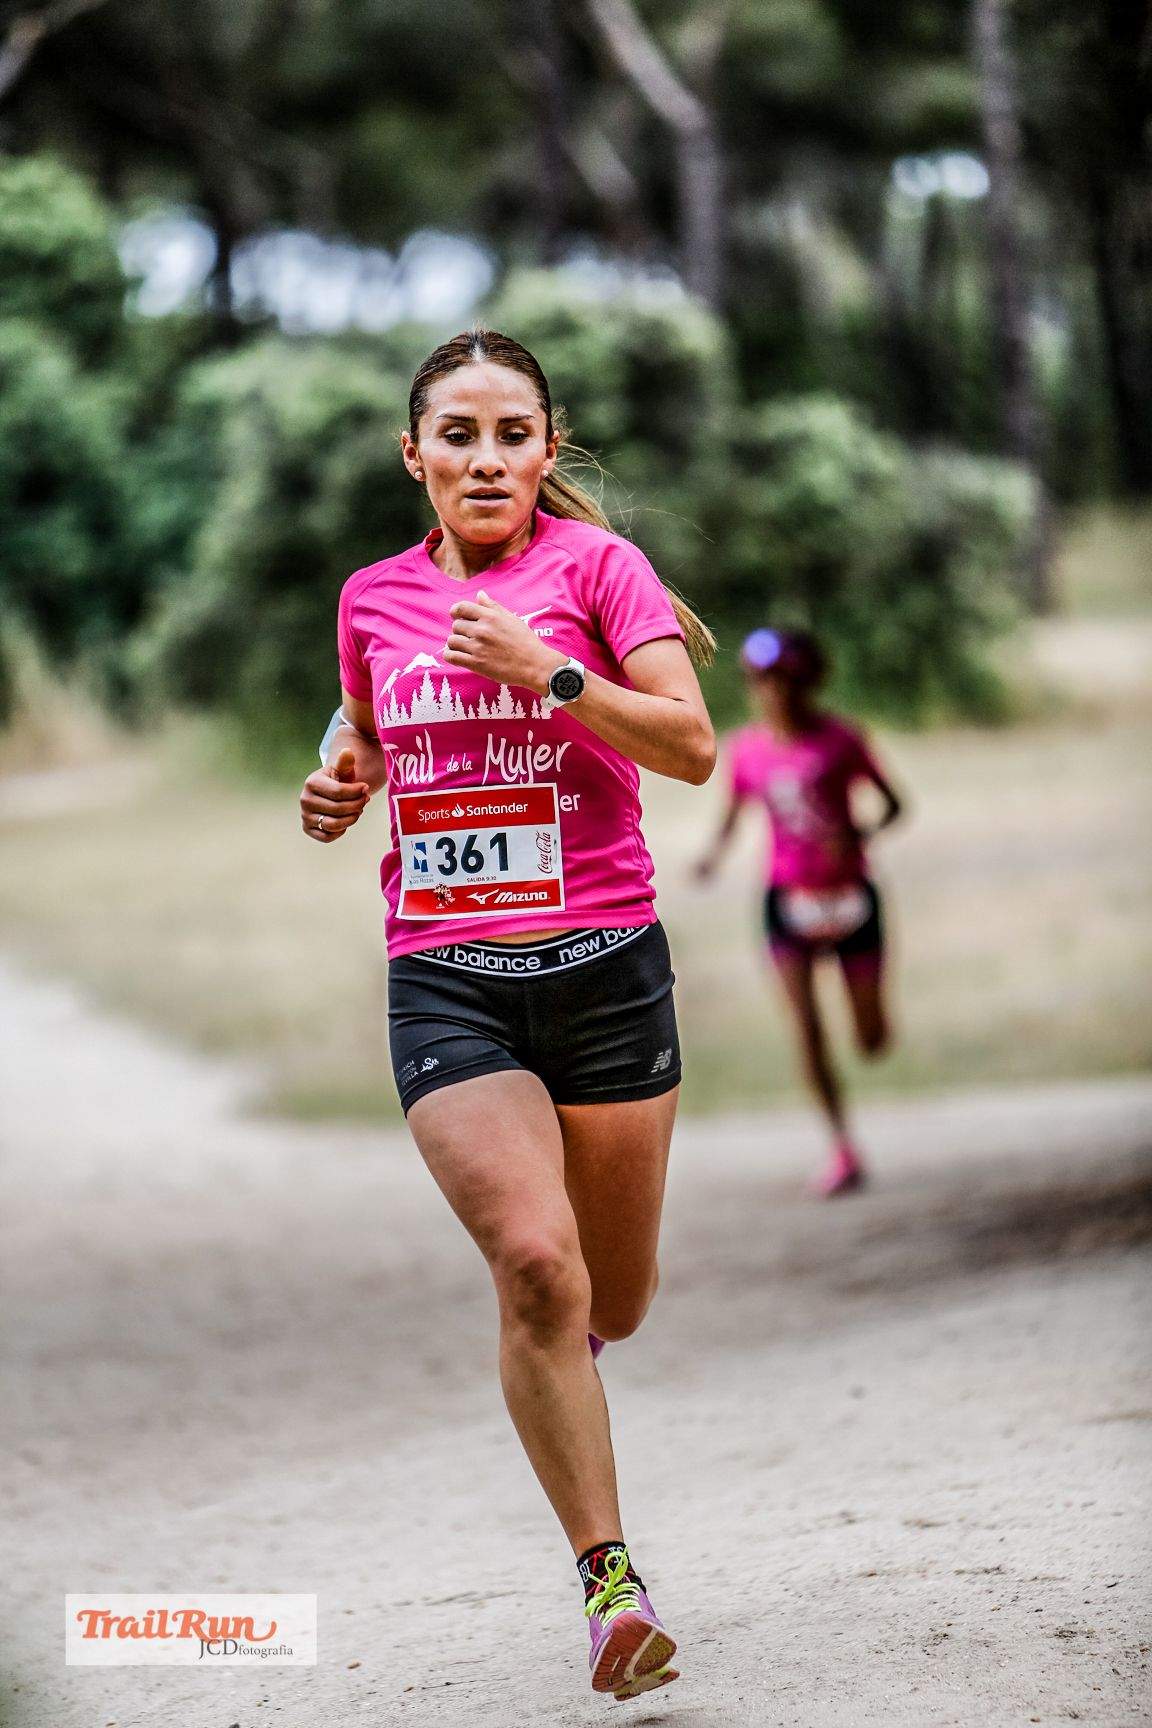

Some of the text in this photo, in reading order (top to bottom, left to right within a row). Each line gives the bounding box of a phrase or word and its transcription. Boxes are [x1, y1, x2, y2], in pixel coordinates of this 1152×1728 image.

[446, 754, 460, 772] de
[462, 753, 473, 770] la
[482, 730, 572, 786] Mujer
[418, 802, 529, 823] Sports Santander
[435, 832, 509, 877] 361
[454, 945, 541, 972] balance
[559, 936, 601, 964] new
